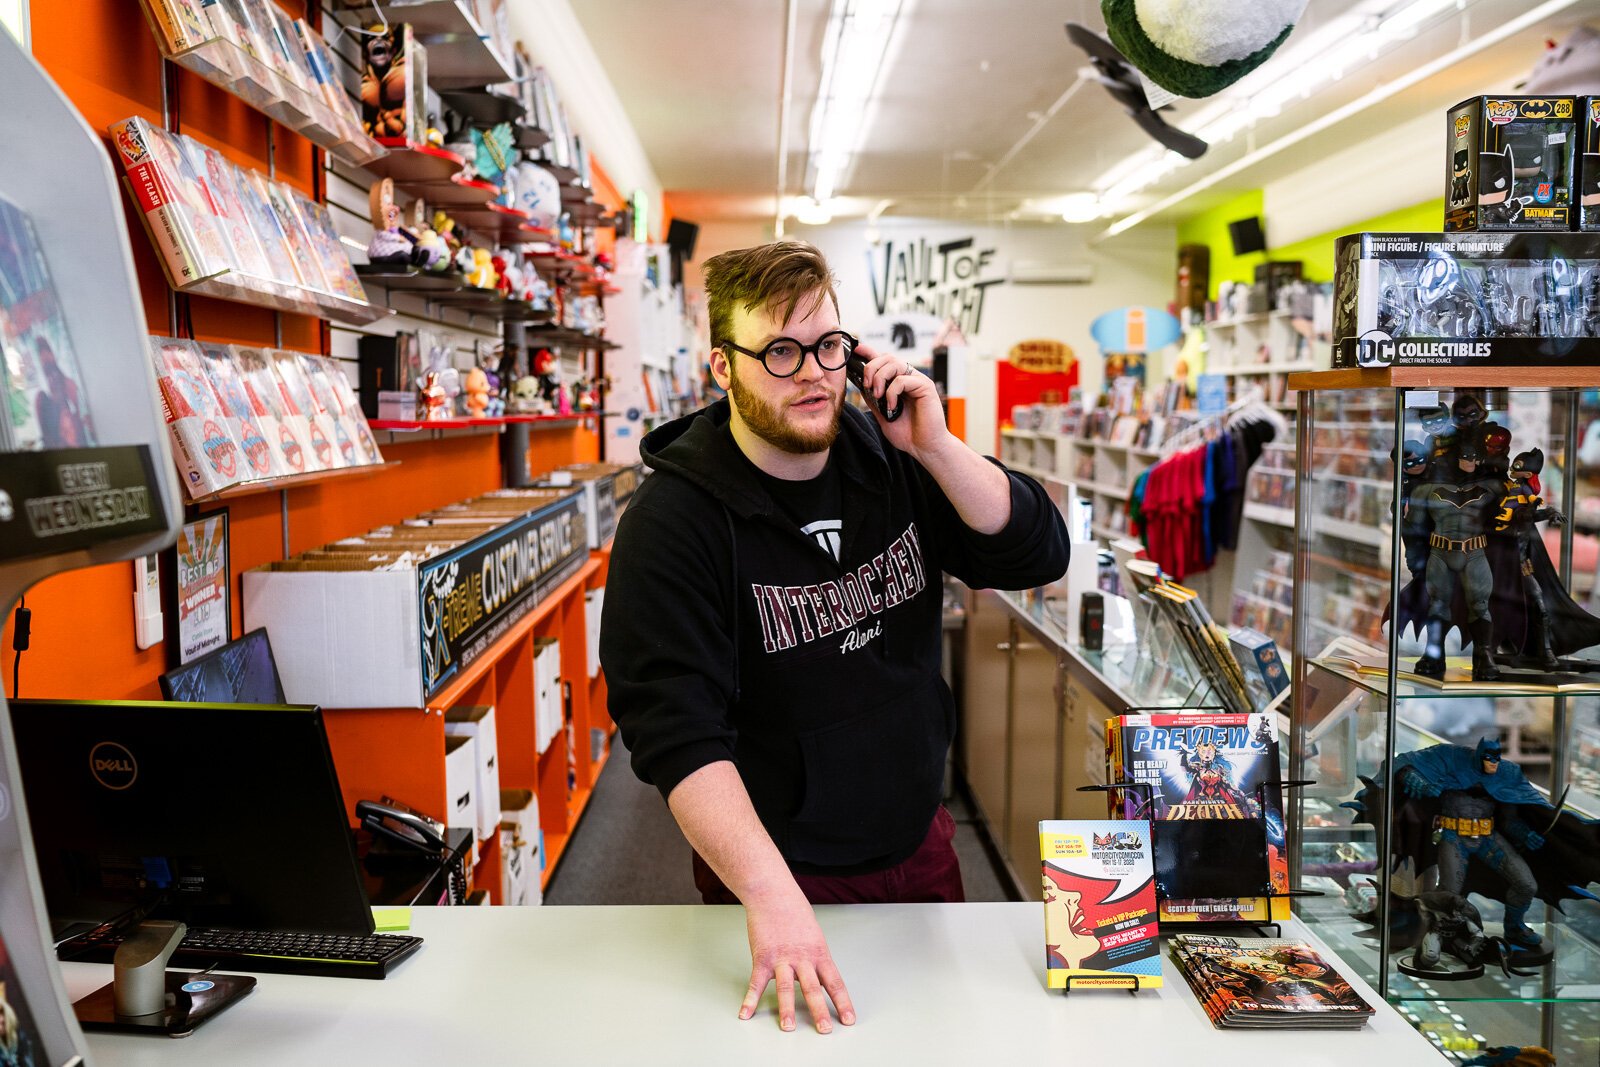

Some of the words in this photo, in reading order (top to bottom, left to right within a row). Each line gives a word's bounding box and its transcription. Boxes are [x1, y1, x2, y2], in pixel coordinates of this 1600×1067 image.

[1486, 101, 1517, 117] POP!
[1556, 104, 1570, 114] 288
[137, 165, 150, 181] THE
[144, 179, 161, 207] FLASH
[1537, 184, 1551, 197] PX
[1524, 209, 1555, 218] BATMAN
[1387, 242, 1418, 252] FIGURE
[1424, 242, 1456, 252] FIGURE
[1457, 242, 1505, 252] MINIATURE
[867, 238, 973, 315] VAULT
[954, 249, 996, 281] OF
[1358, 339, 1395, 363] DC
[1399, 342, 1492, 357] COLLECTIBLES
[24, 485, 150, 538] WEDNESDAY
[481, 529, 539, 615] CUSTOMER
[539, 511, 572, 572] SERVICE
[180, 562, 204, 589] BEST
[751, 522, 927, 653] INTEROCHEN
[185, 583, 216, 611] WINNER
[201, 634, 220, 649] Midnight
[95, 759, 132, 771] DELL
[1133, 760, 1146, 768] GET
[1147, 760, 1168, 769] READY
[1134, 769, 1147, 777] FOR
[1147, 769, 1160, 777] THE
[1134, 778, 1163, 787] ENCORE!
[1166, 803, 1246, 820] DEATH
[1091, 851, 1144, 860] MOTORCITYCOMICCON
[1167, 905, 1186, 913] SCOTT
[1187, 905, 1210, 913] SNYDER
[1213, 904, 1228, 912] GREG
[1228, 904, 1254, 912] CAPULLO
[1096, 916, 1114, 927] Tickets
[1117, 912, 1126, 922] VIP
[1125, 908, 1148, 920] Packages
[1103, 940, 1117, 948] SKIP
[1128, 932, 1145, 941] LINES
[1108, 934, 1121, 942] YOU
[1120, 930, 1139, 940] WANT
